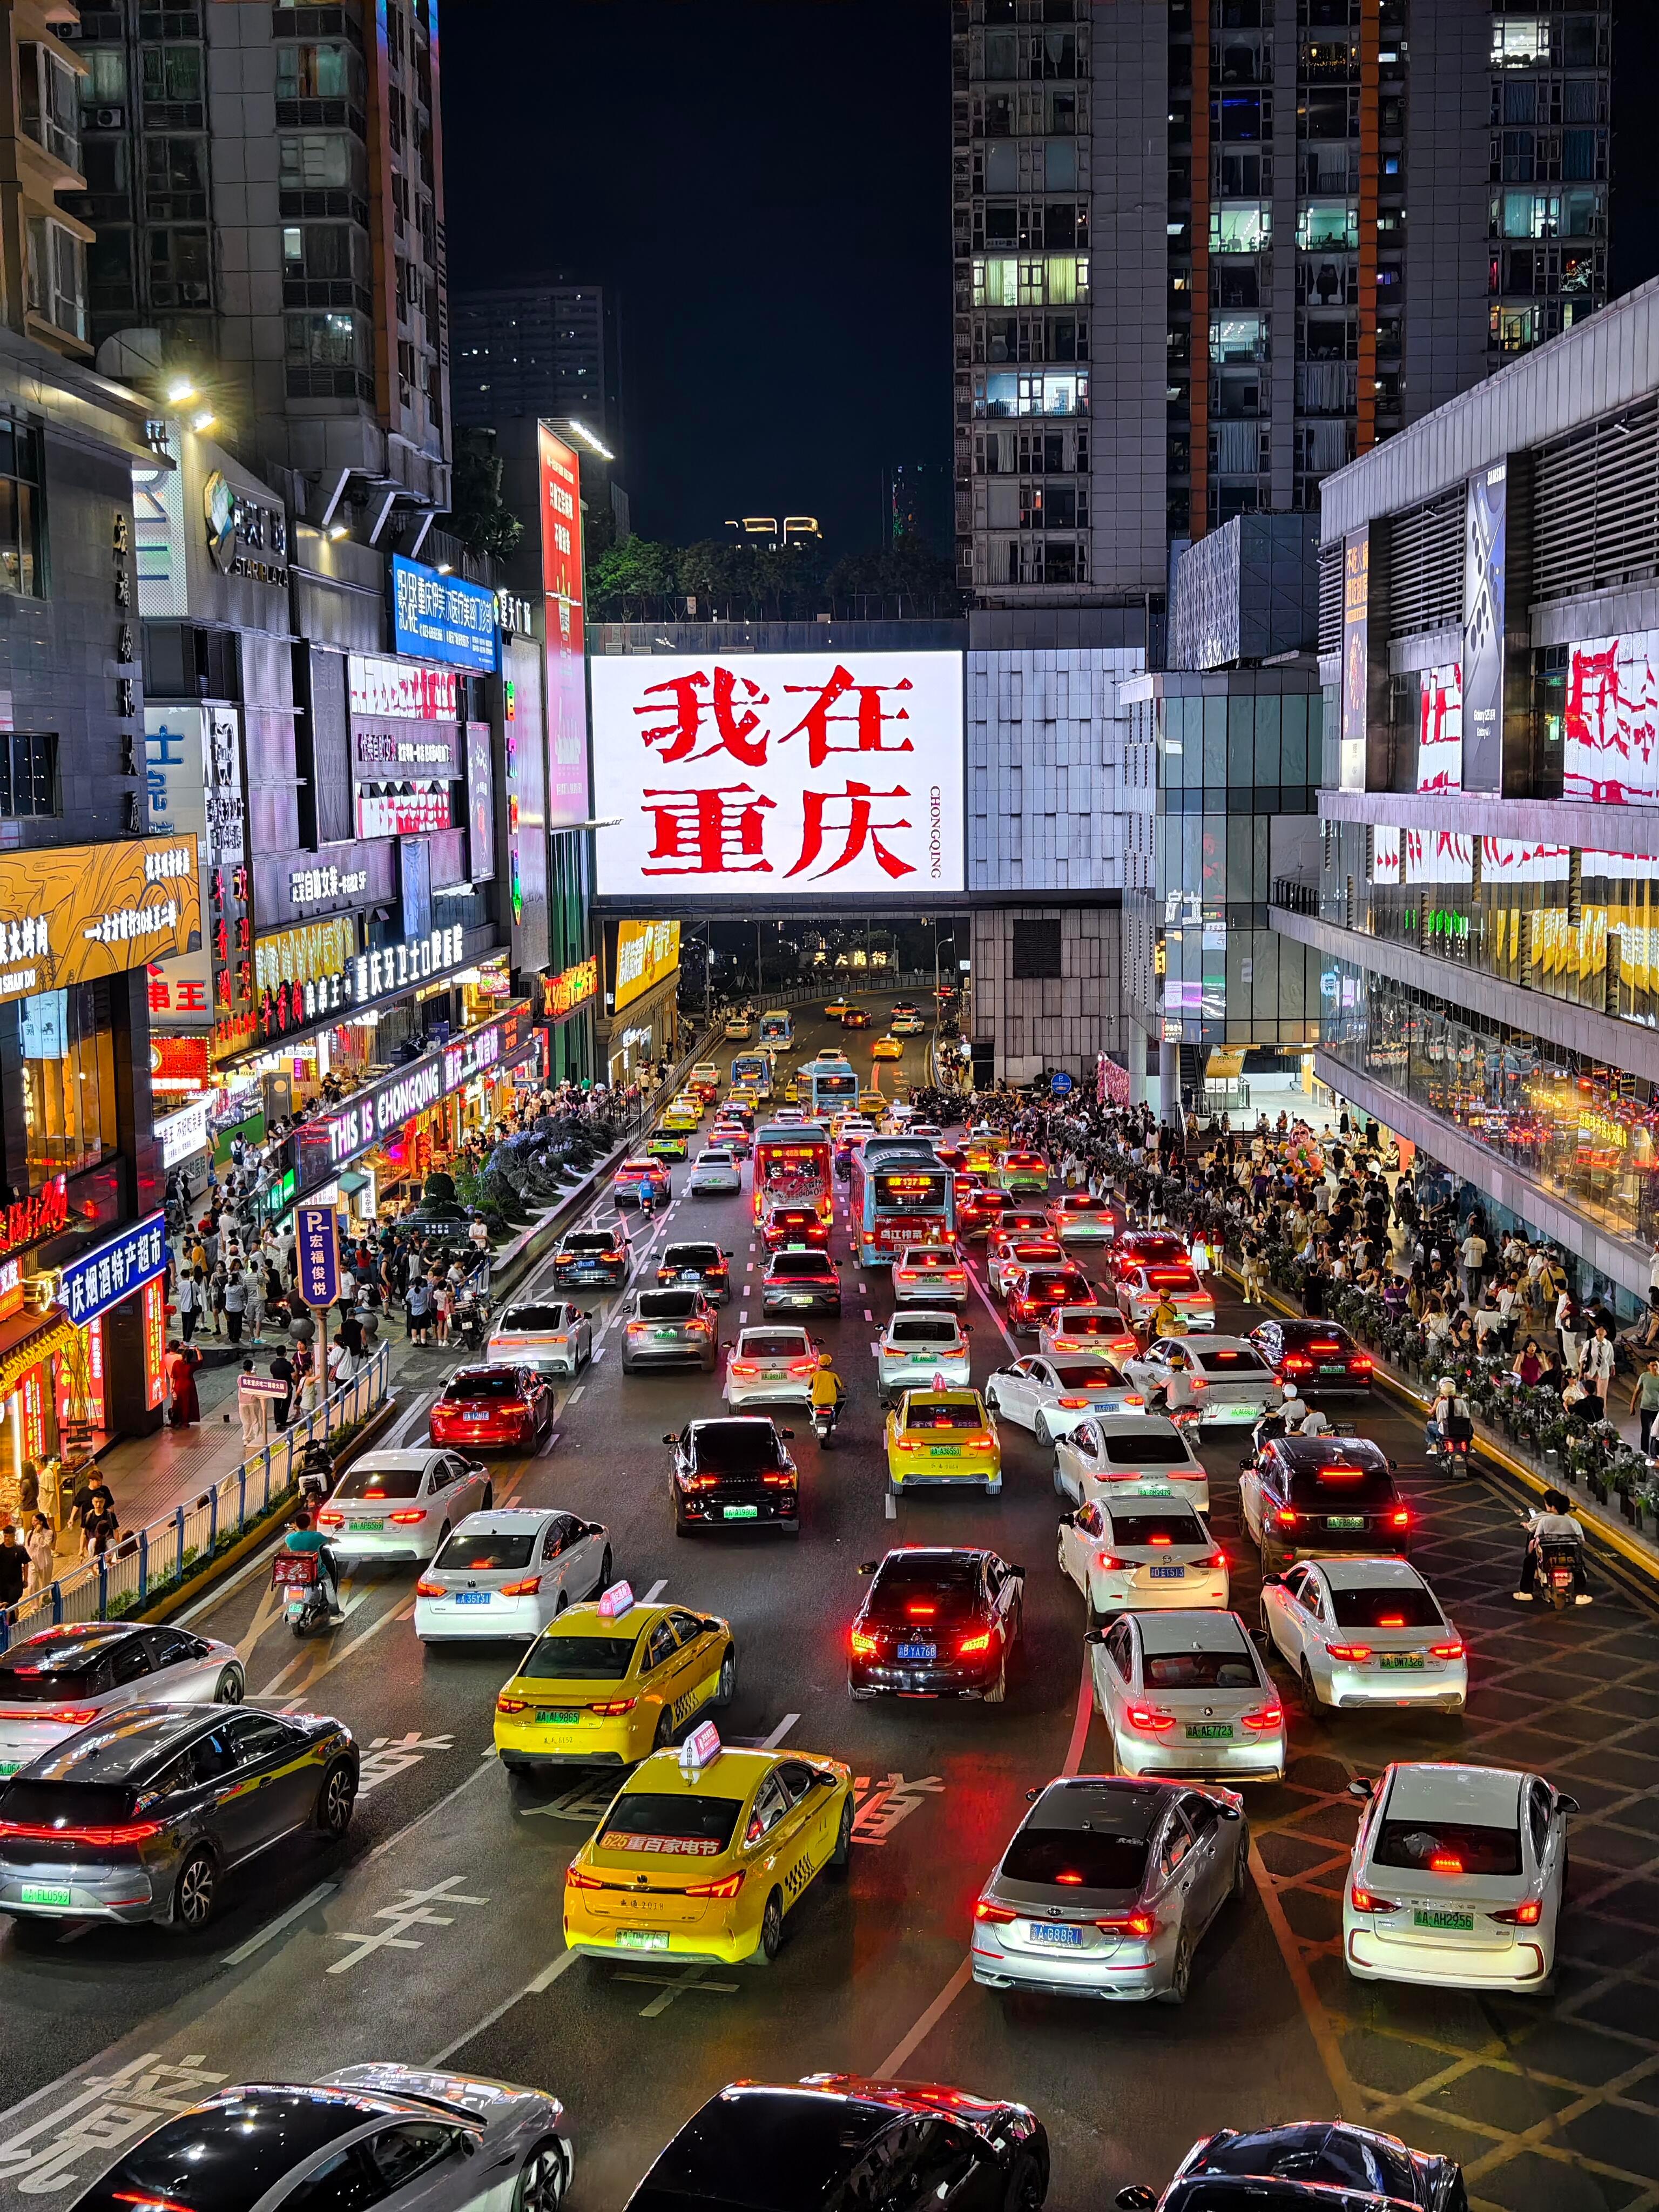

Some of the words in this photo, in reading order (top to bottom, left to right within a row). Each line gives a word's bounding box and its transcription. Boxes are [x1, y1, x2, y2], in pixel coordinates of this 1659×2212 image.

[236, 556, 259, 582] STAR
[259, 563, 289, 588] PLAZA
[501, 594, 531, 635] 星天广场
[633, 664, 914, 768] 我在
[1474, 709, 1485, 724] Galaxy
[641, 780, 918, 881] 重庆
[929, 786, 941, 879] CHONGQING
[356, 923, 463, 1002] 重庆牙卫士口腔医院
[287, 1048, 314, 1056] 自助女装
[445, 1050, 463, 1092] 重庆
[329, 1110, 358, 1162] THIS
[361, 1100, 374, 1142] IS
[378, 1063, 439, 1130] CHONGQING
[307, 1211, 322, 1232] P
[880, 1230, 922, 1240] 乌江榨菜
[58, 1227, 161, 1319] 重庆烟酒特产超市
[309, 1234, 327, 1296] 宏福俊悦
[326, 1876, 491, 1974] 车
